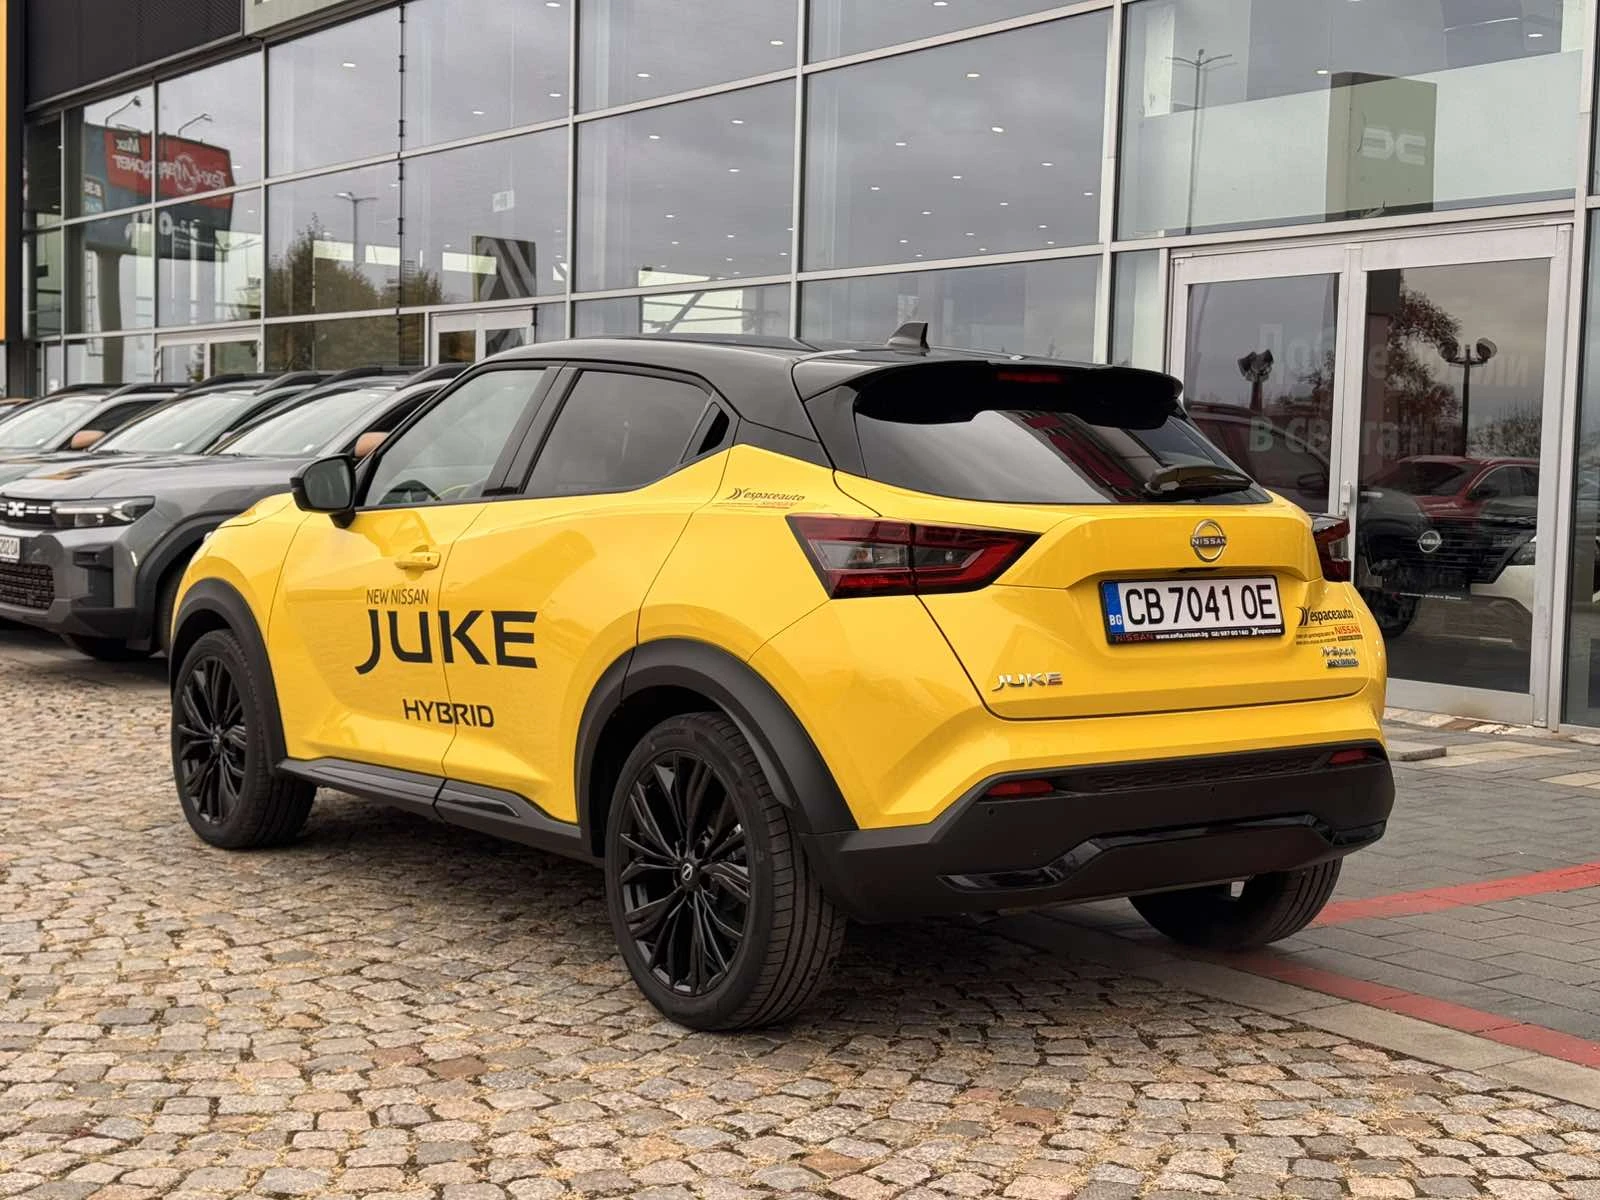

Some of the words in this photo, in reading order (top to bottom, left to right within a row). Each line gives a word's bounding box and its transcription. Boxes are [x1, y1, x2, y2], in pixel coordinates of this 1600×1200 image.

[743, 490, 806, 501] espaceauto
[1191, 536, 1226, 545] NISSAN
[366, 589, 389, 604] NEW
[391, 588, 429, 605] NISSAN
[1109, 614, 1122, 625] BG
[1310, 608, 1354, 625] espaceauto
[1334, 625, 1361, 636] NISSAN
[355, 609, 538, 675] JUKE
[991, 672, 1063, 692] JUKE
[402, 698, 494, 728] HYBRID
